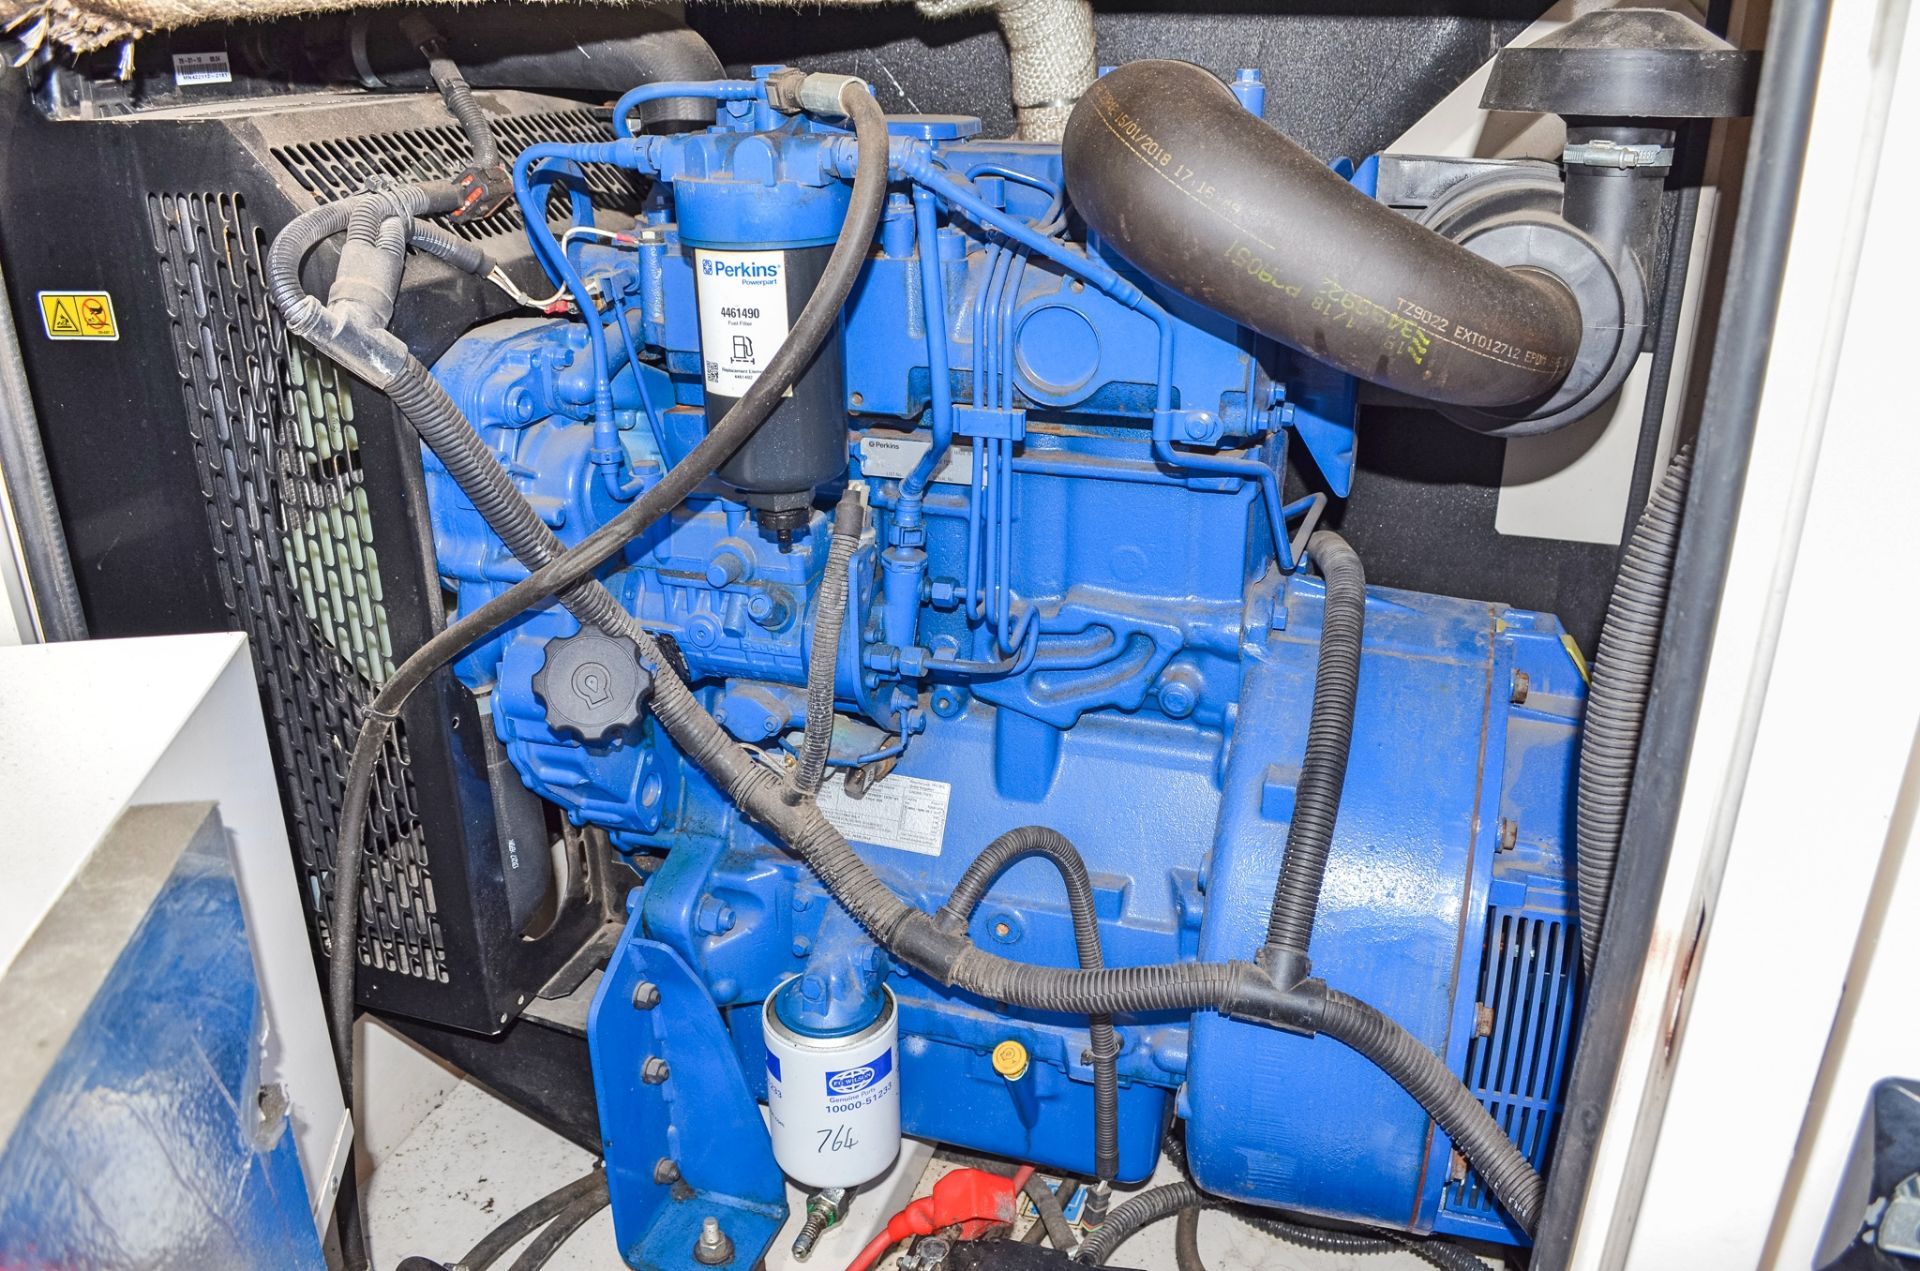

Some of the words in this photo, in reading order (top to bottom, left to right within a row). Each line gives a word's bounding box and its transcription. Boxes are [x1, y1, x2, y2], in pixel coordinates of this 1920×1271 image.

[1114, 111, 1172, 167] 15/01/2018
[715, 261, 777, 277] Perkins
[721, 307, 760, 319] 4461490
[1397, 297, 1449, 333] TZ9022
[825, 1081, 893, 1113] 10000-51233
[829, 1091, 859, 1103] Genuine
[861, 1087, 876, 1097] Parts
[817, 1124, 859, 1153] 764
